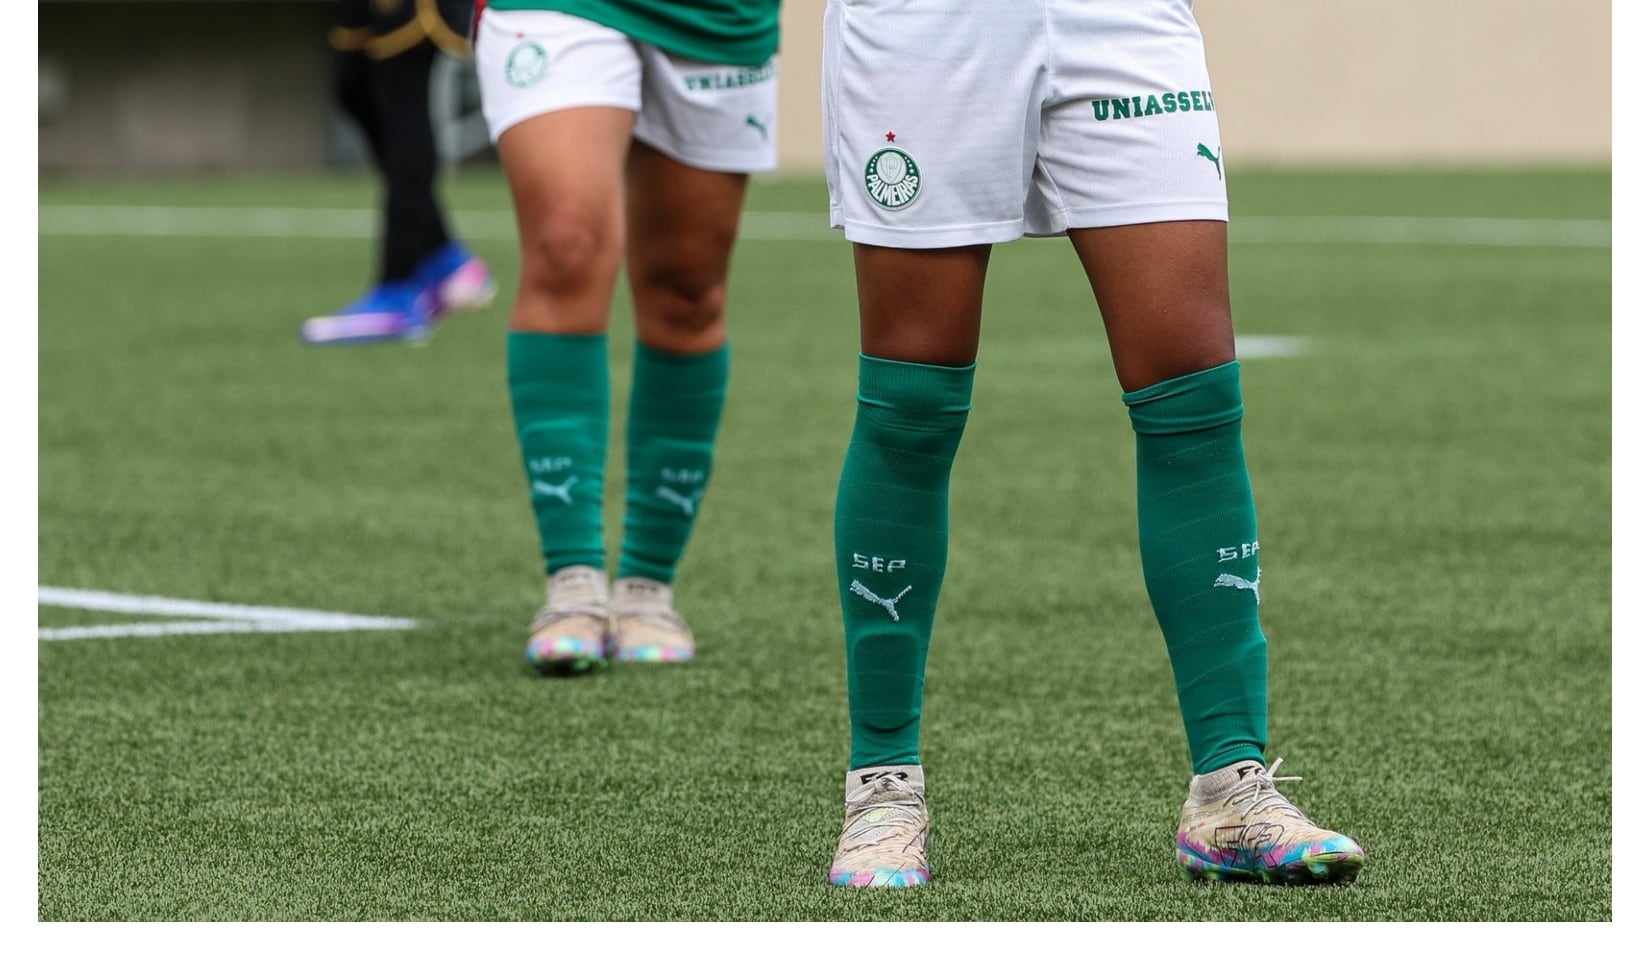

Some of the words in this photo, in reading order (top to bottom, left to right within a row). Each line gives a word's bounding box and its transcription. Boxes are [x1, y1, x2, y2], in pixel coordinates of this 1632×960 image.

[866, 174, 919, 207] PALMEIRAS
[1216, 540, 1259, 562] SEP
[853, 552, 906, 574] SEP
